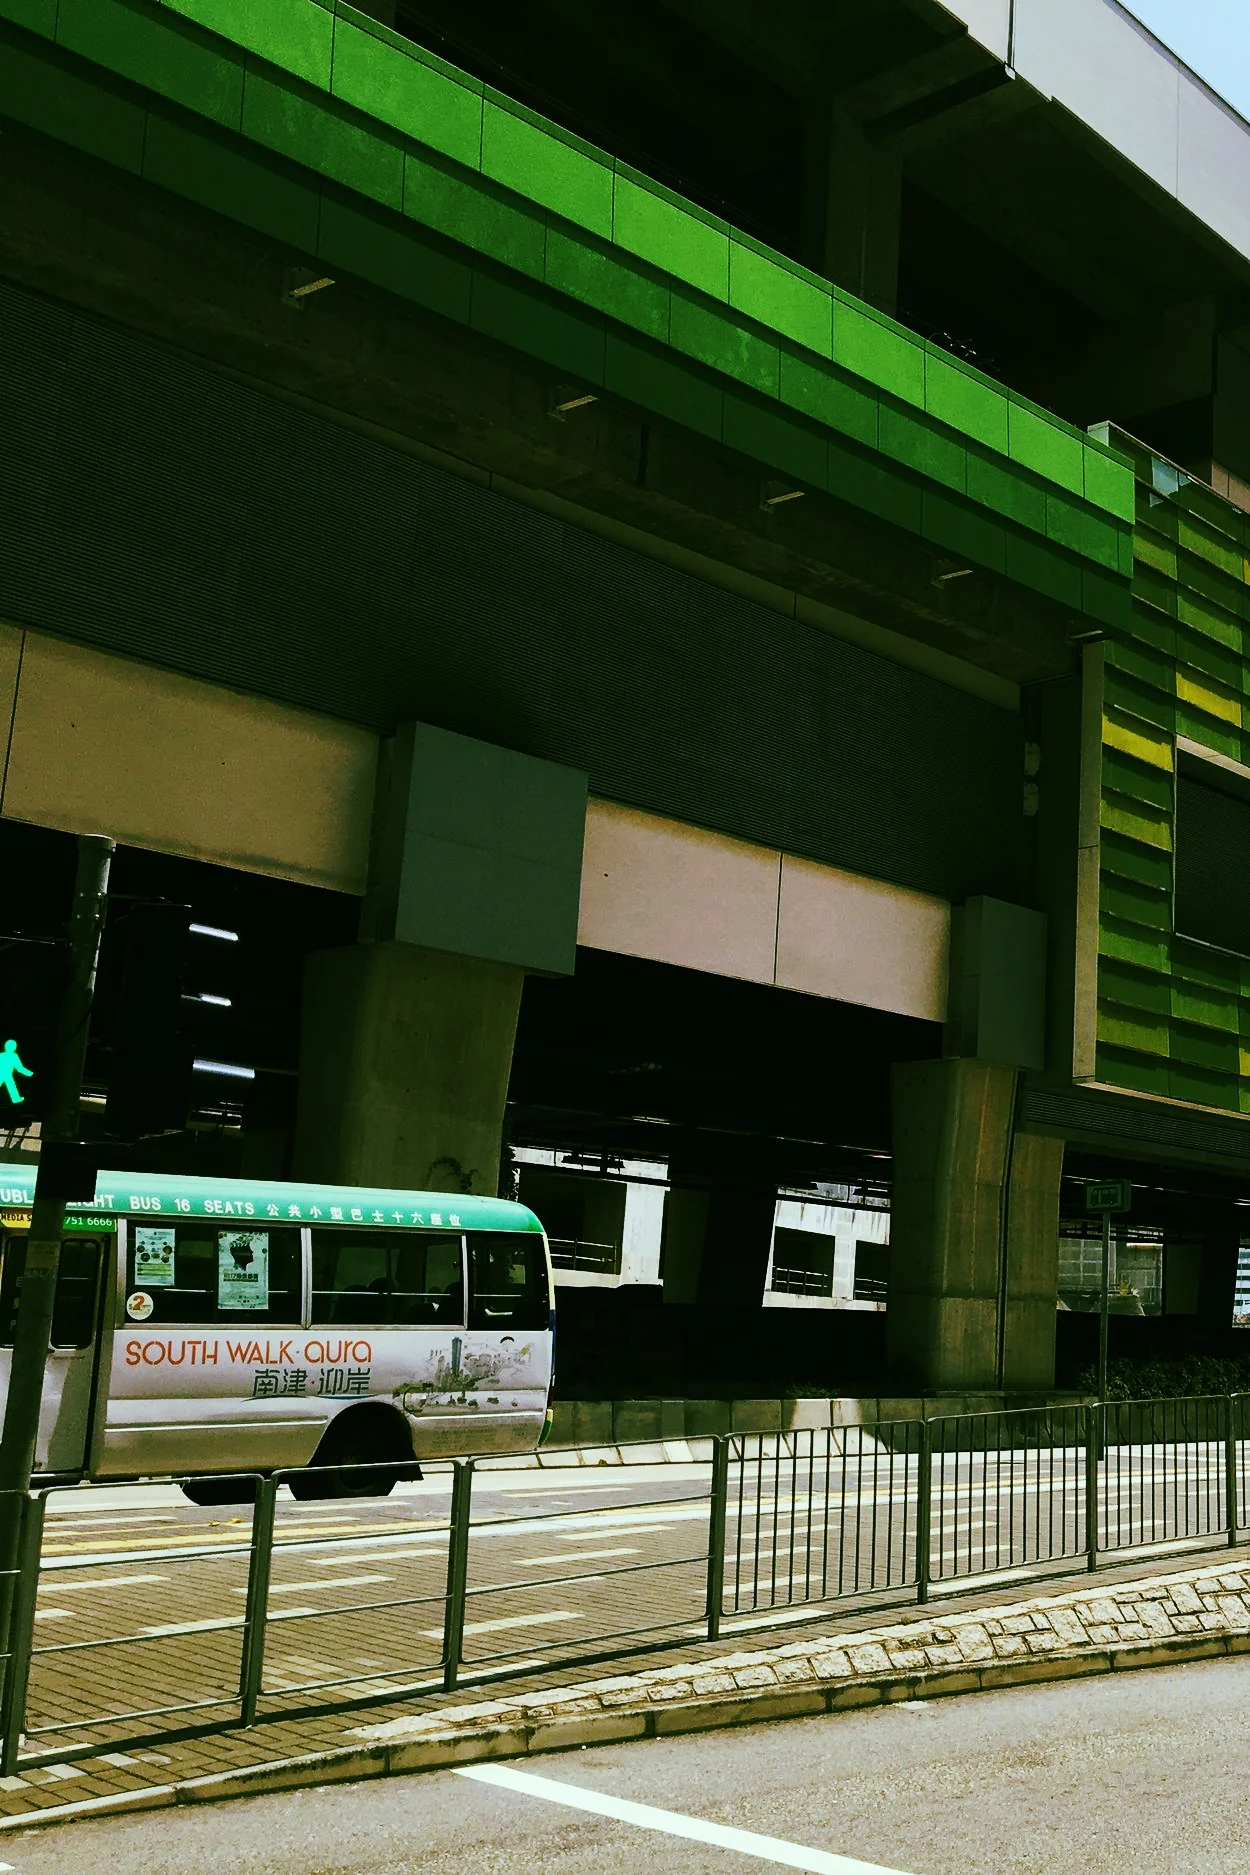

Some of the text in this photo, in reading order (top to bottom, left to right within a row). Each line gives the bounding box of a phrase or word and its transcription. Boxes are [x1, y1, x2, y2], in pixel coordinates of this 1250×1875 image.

[0, 1187, 34, 1204] UBL
[129, 1195, 161, 1211] BUS
[174, 1199, 191, 1212] 16
[204, 1199, 255, 1215] SEATS
[65, 1216, 113, 1227] 751 6666
[266, 1203, 462, 1227] 公共小型巴士十六座位
[125, 1340, 373, 1366] SOUTH WALK aura
